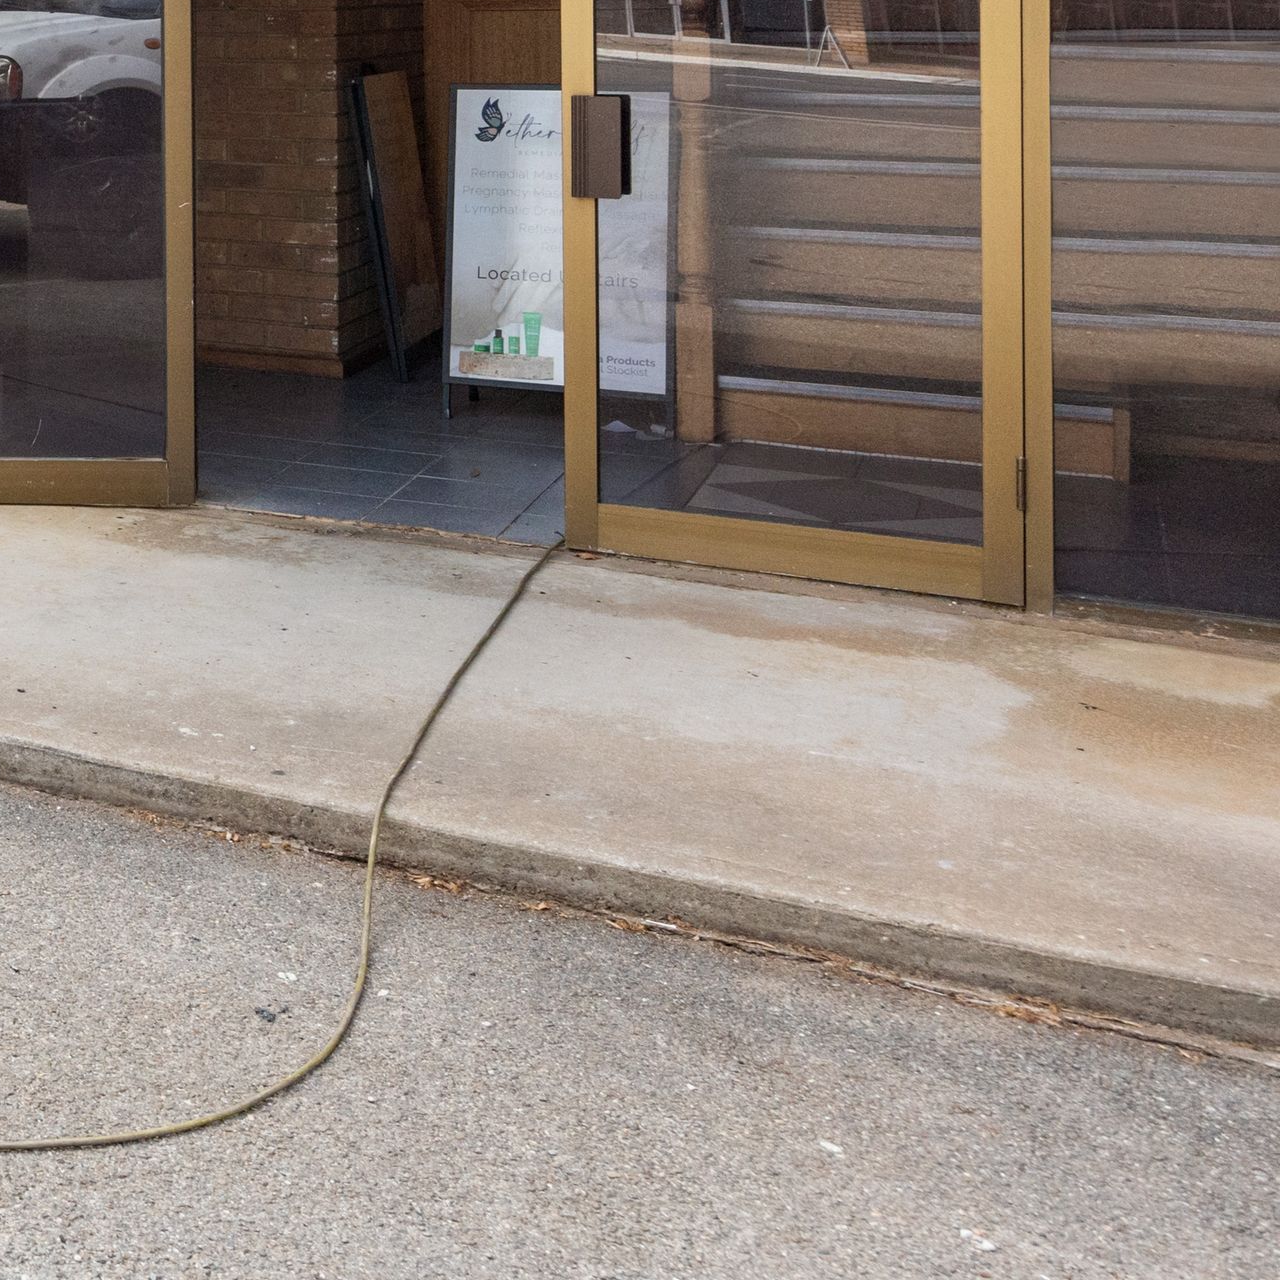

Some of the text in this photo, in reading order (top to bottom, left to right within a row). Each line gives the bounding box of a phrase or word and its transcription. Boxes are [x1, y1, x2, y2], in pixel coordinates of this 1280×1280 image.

[471, 167, 529, 180] Remedial
[462, 185, 528, 199] Pregnancy
[464, 204, 530, 219] Lymphatic
[477, 266, 552, 283] Located
[606, 355, 656, 368] Products
